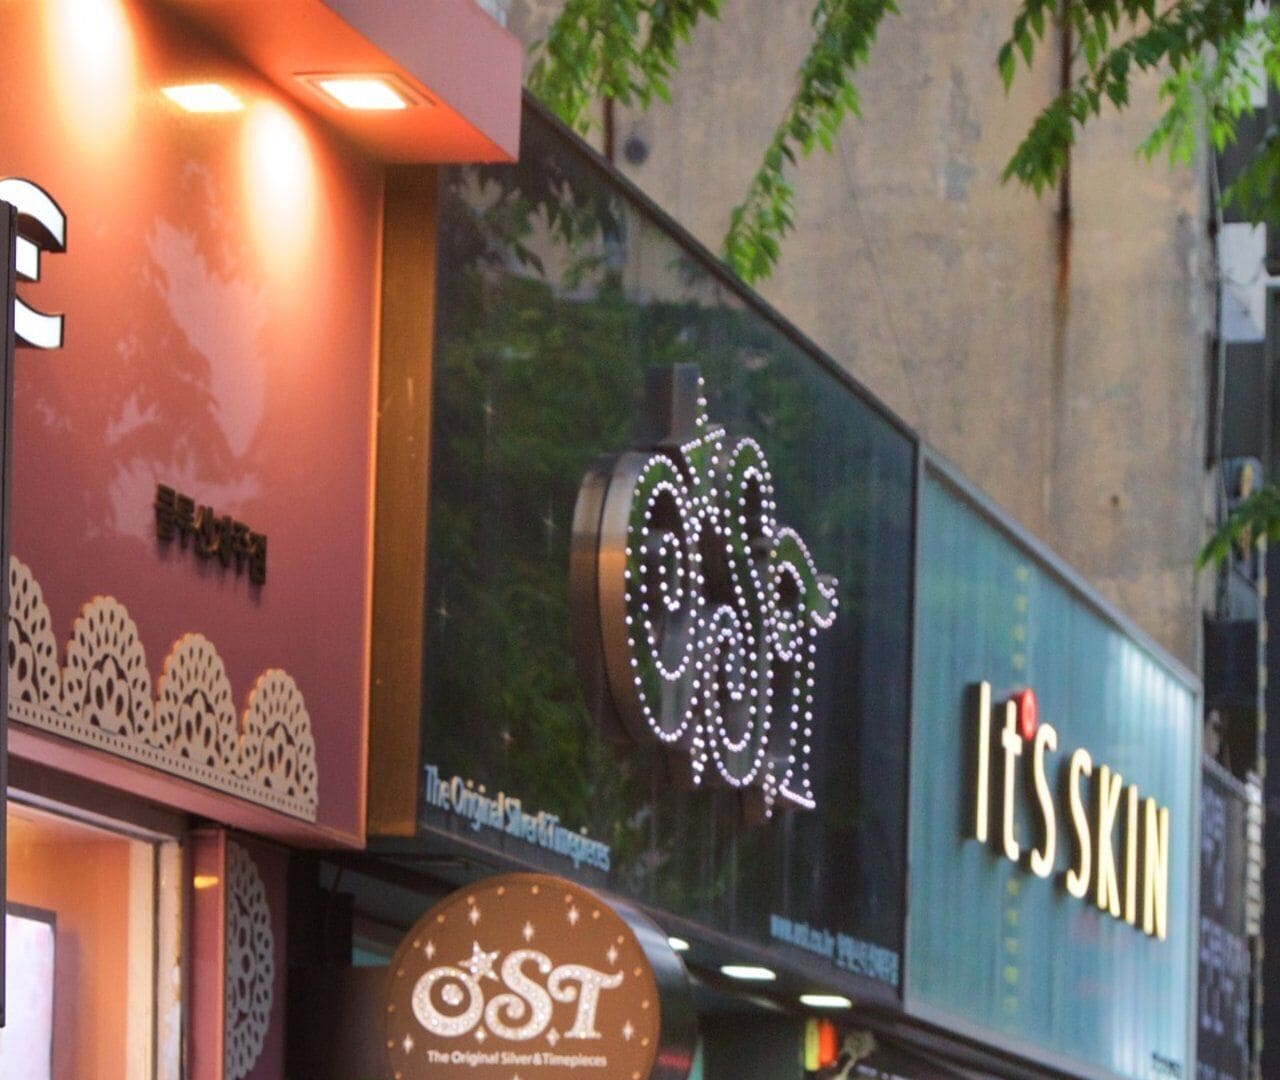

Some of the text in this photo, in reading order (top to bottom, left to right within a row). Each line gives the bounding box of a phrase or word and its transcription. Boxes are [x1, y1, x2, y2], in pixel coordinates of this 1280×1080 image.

[1066, 747, 1169, 942] SKIN
[427, 1050, 607, 1067] The Original Silver&Timepieces
